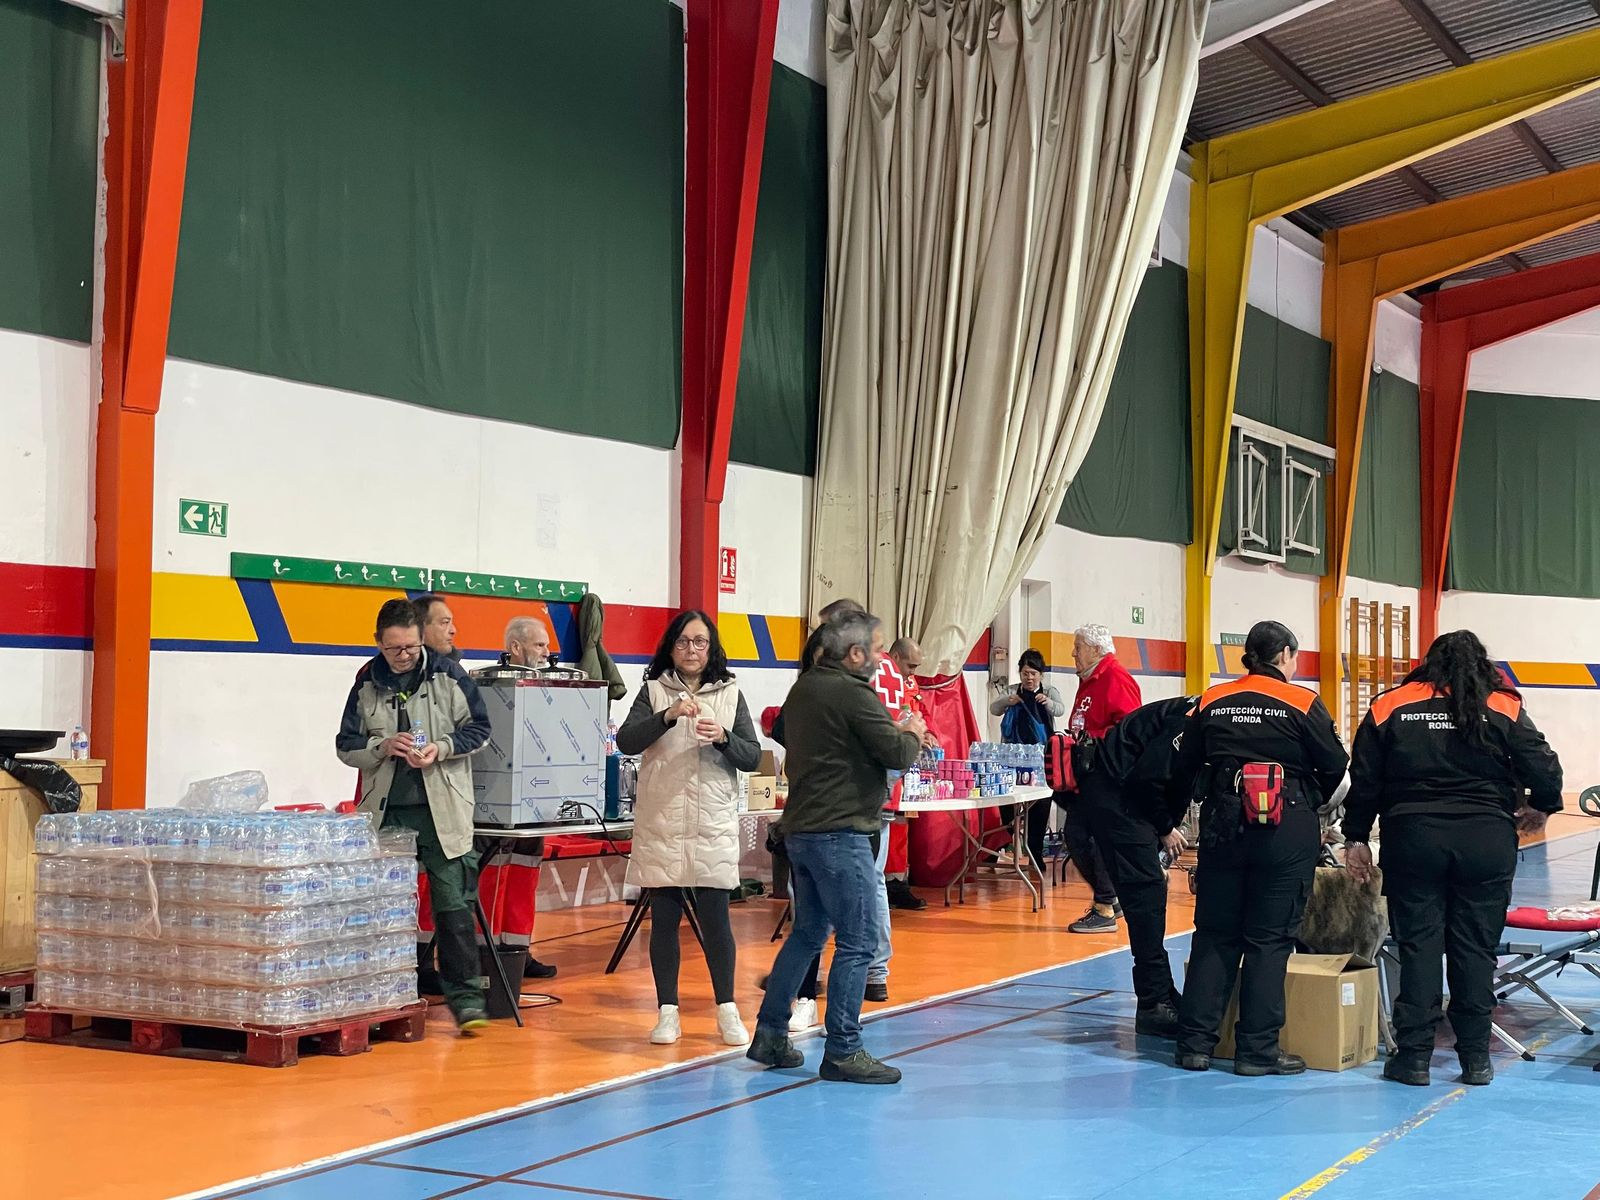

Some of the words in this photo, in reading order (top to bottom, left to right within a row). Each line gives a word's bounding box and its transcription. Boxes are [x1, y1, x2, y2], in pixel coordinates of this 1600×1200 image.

[1210, 706, 1263, 716] PROTECCIÓN
[1264, 708, 1288, 718] CIVIL
[1232, 715, 1262, 724] RONDA
[1401, 713, 1449, 721] PROTECCI
